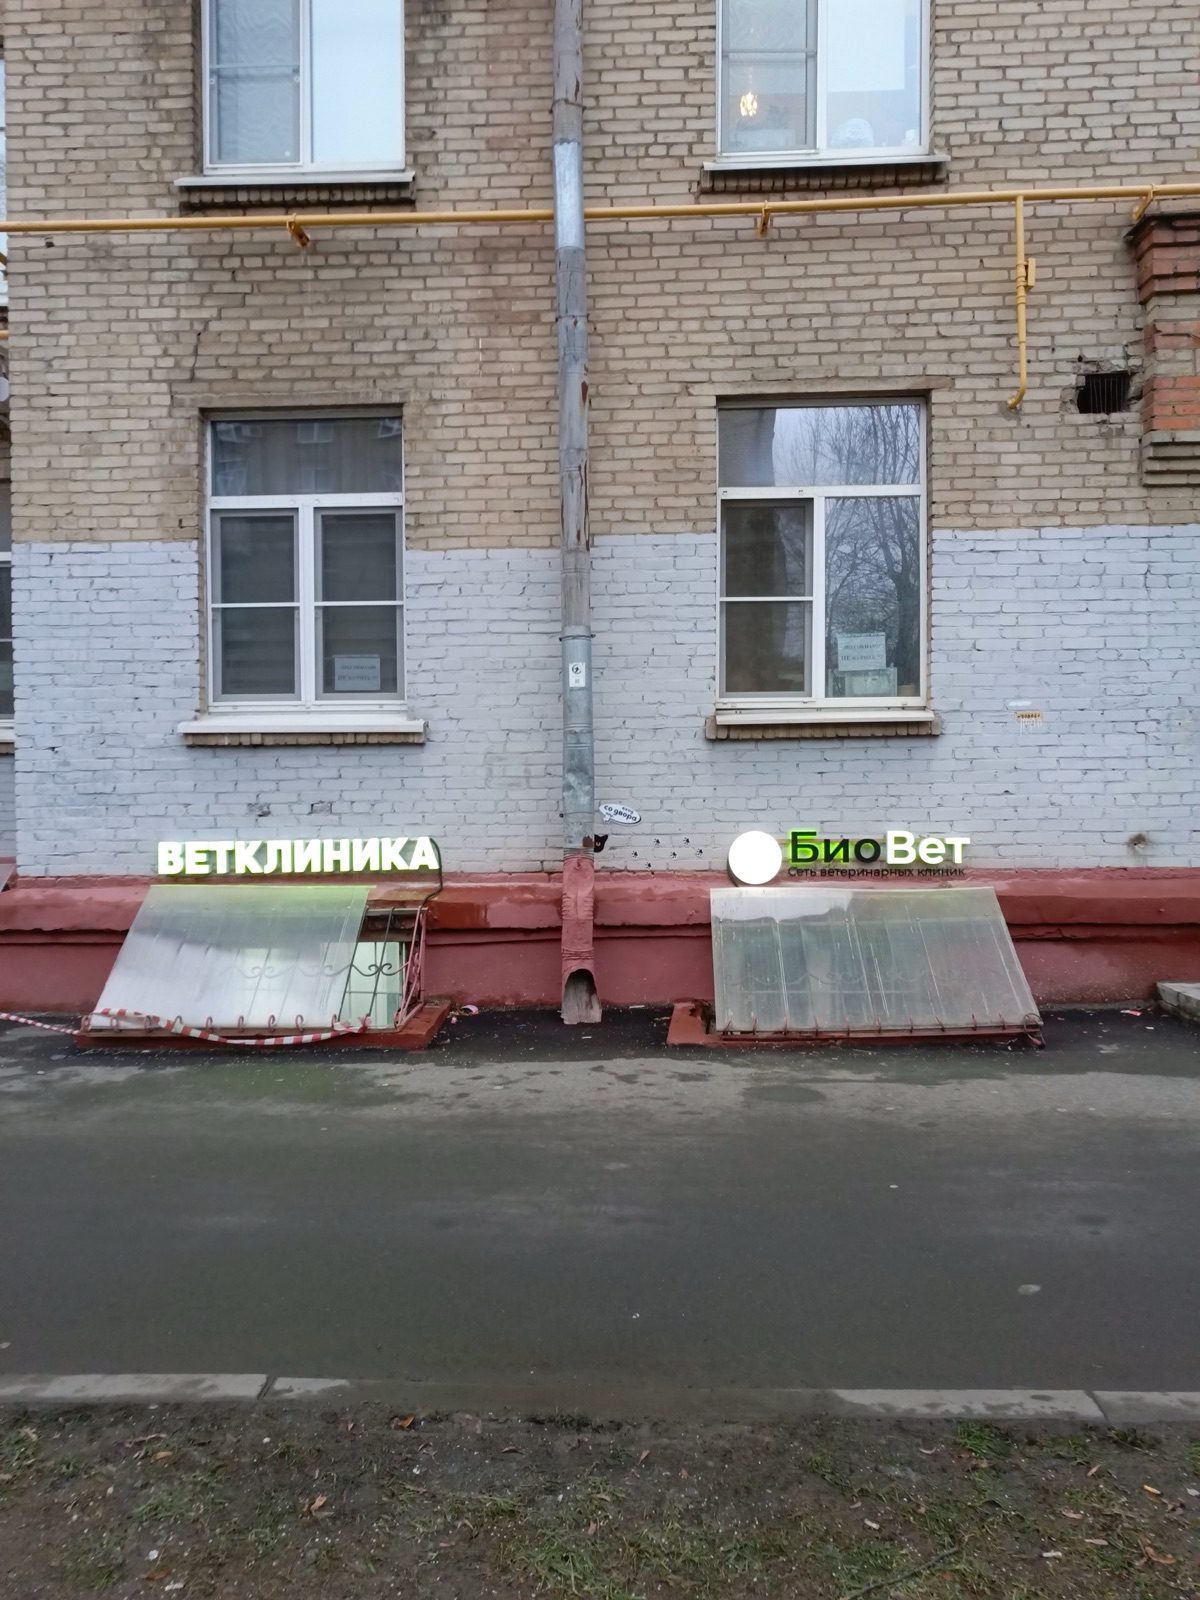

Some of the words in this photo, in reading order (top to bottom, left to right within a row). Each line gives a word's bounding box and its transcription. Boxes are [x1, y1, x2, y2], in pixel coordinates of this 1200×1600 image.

[158, 836, 440, 874] ВЕТКЛИНИКА
[791, 830, 971, 864] БиоВет
[788, 868, 817, 877] Сеть
[820, 868, 914, 879] ветеринарных
[917, 868, 967, 877] клиник
